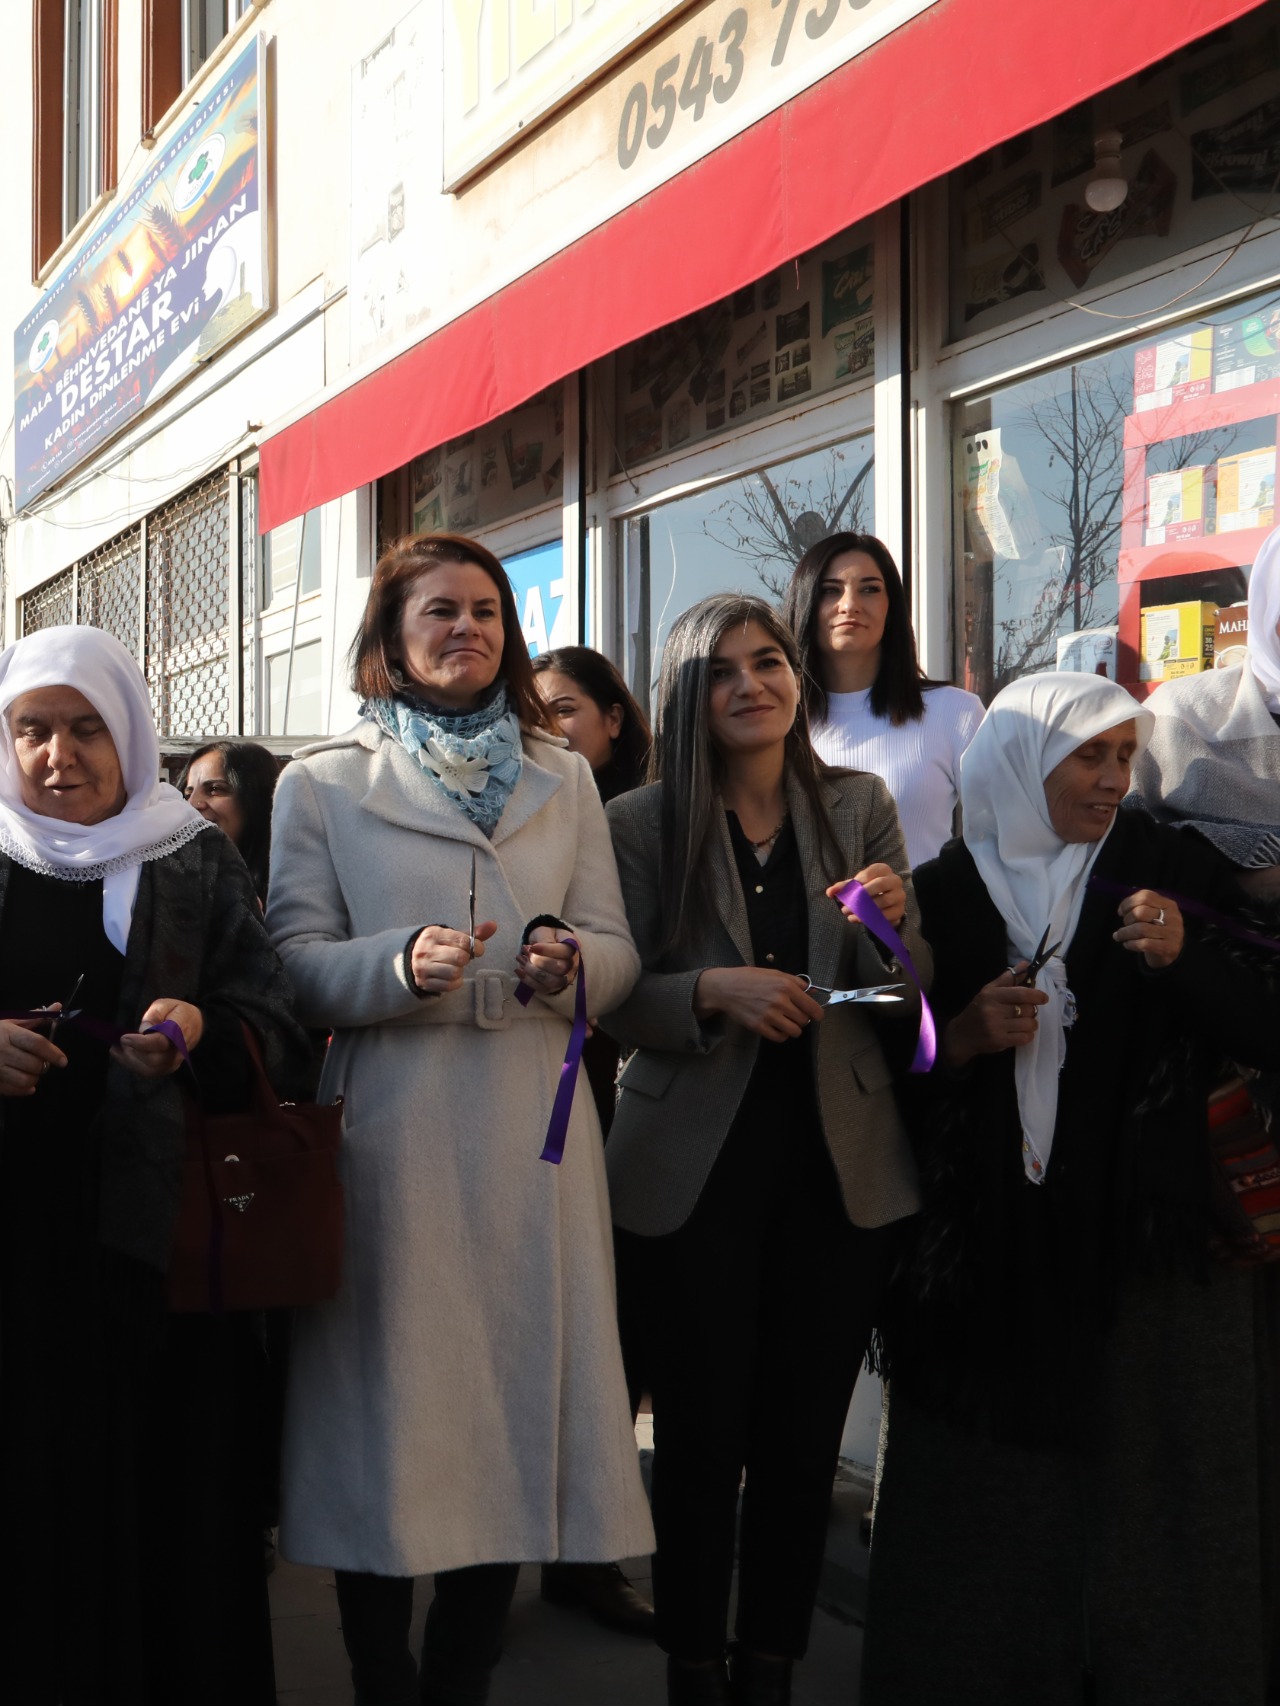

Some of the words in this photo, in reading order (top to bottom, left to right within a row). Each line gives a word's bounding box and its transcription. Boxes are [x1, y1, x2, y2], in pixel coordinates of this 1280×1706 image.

[618, 8, 748, 170] 0543
[20, 391, 53, 432] MALA
[55, 287, 150, 395] BÊHNVEDANÊ
[153, 266, 178, 294] YA
[182, 193, 246, 269] JINAN
[61, 290, 174, 418] DESTAR
[45, 403, 85, 450] KADIN
[1219, 620, 1248, 634] MAH
